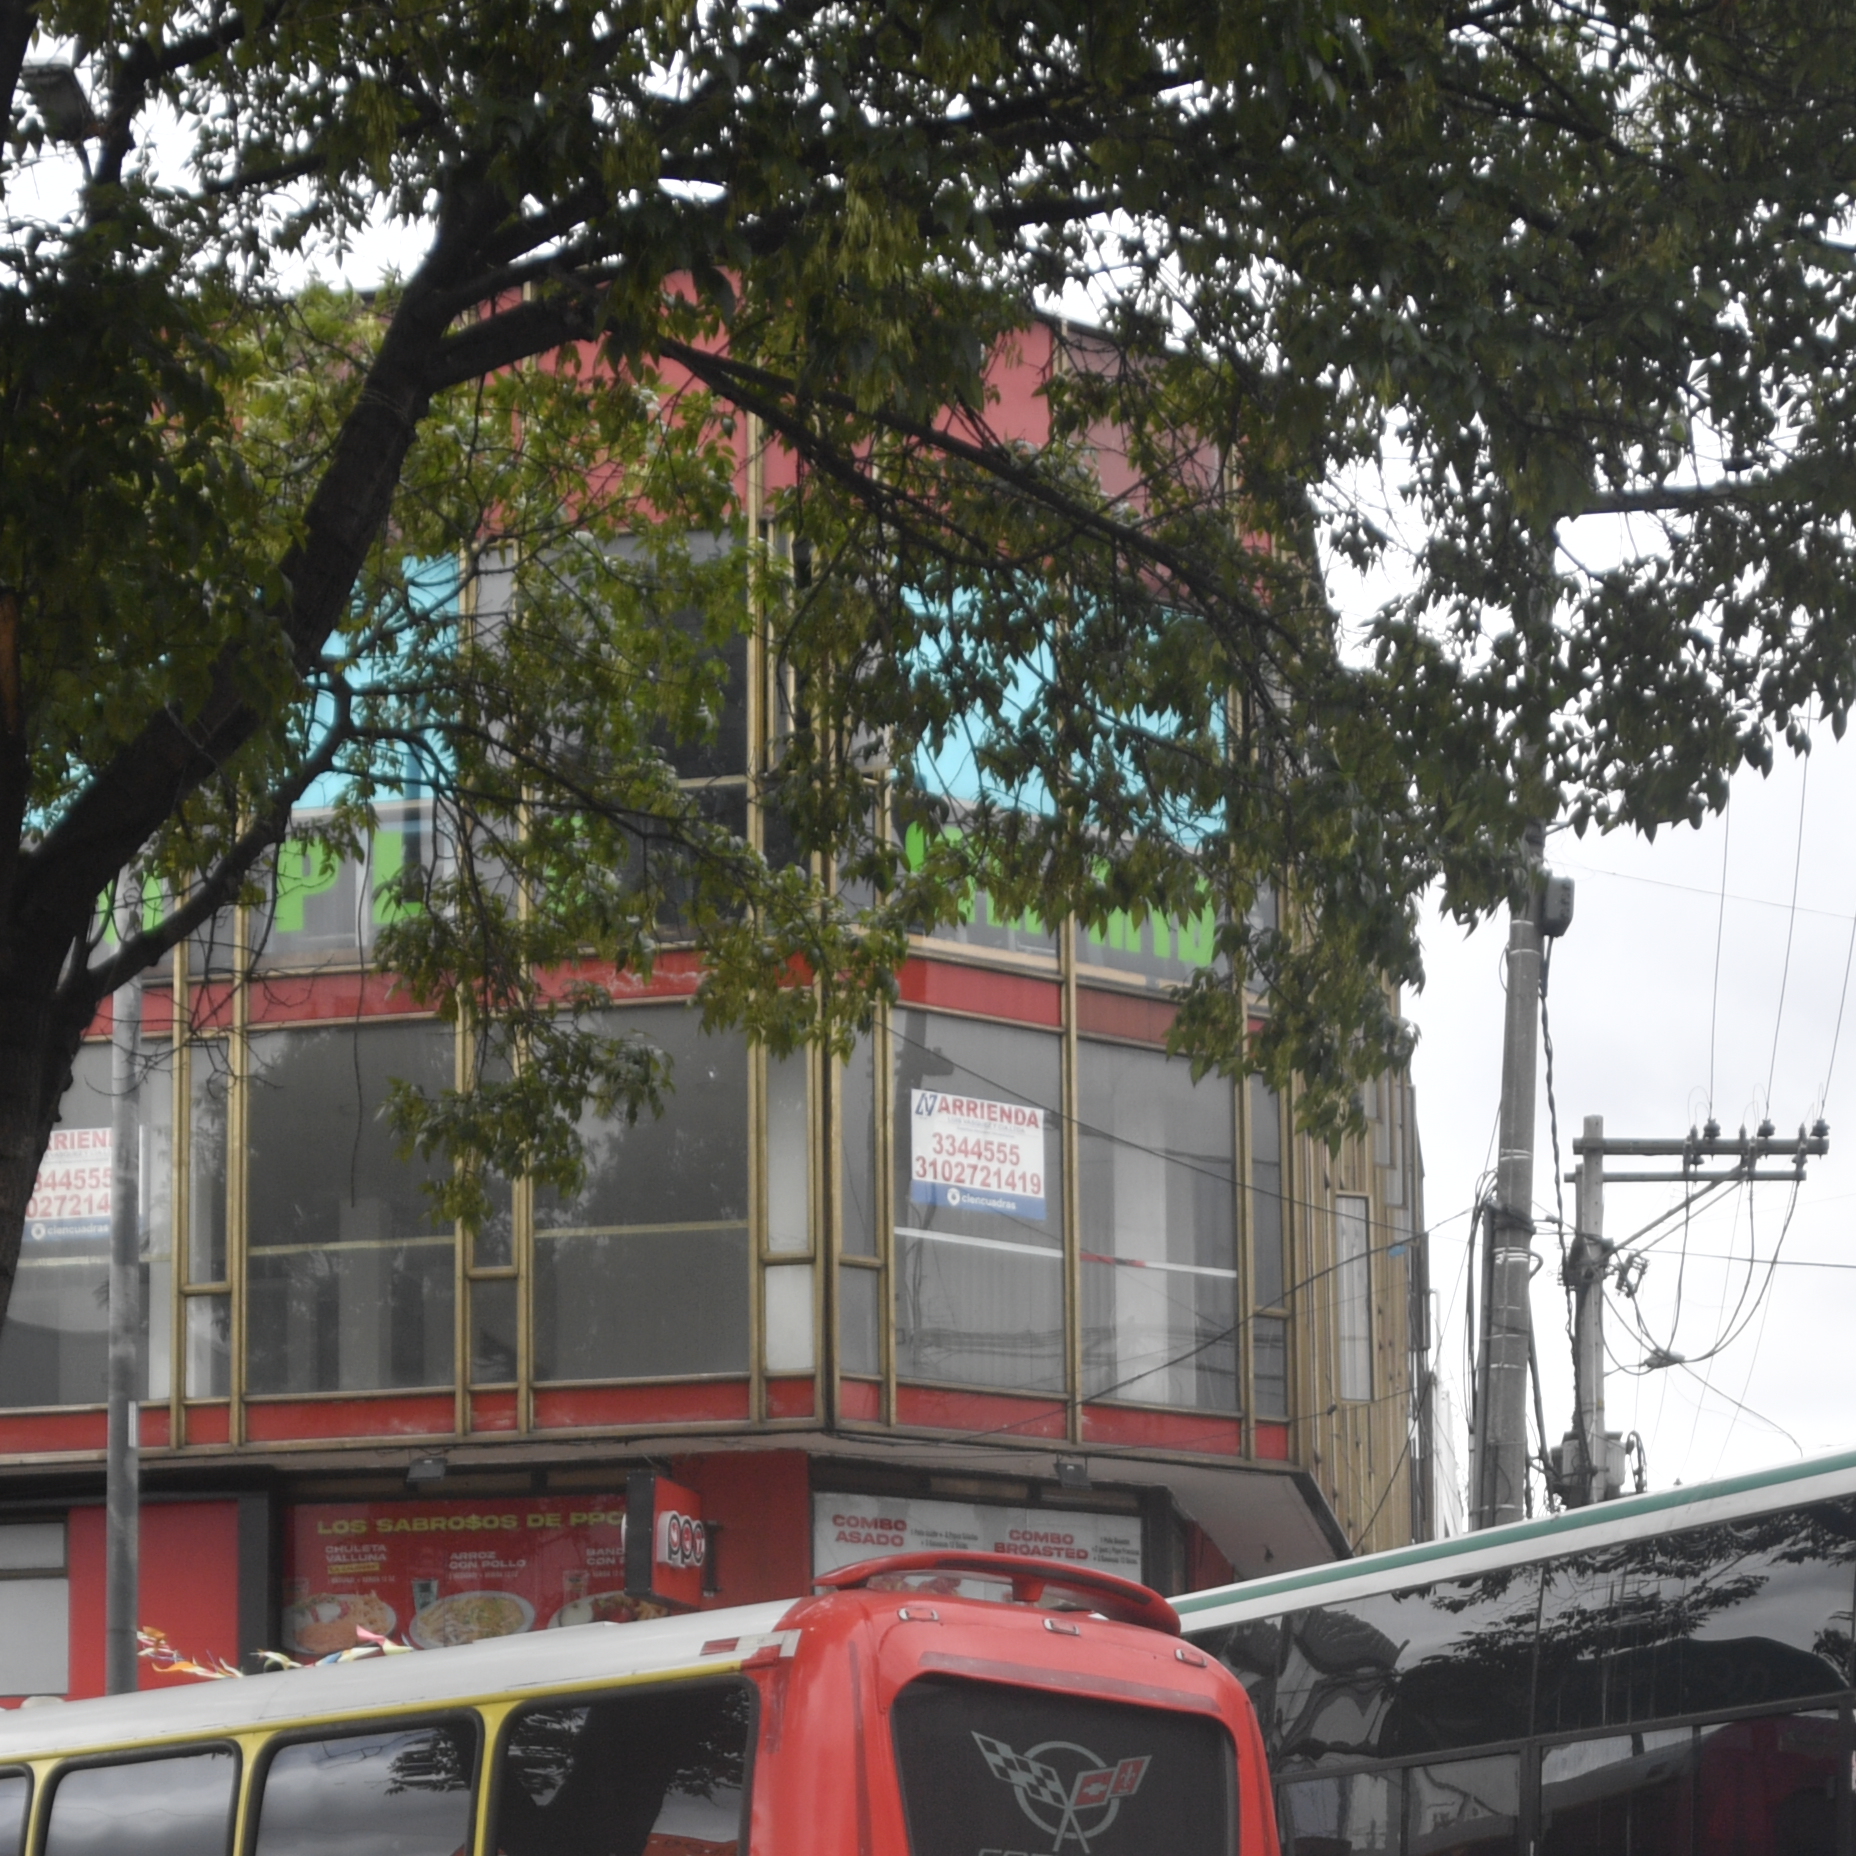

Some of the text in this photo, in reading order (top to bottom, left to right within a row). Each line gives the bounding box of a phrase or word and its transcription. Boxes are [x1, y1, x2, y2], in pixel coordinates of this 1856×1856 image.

[937, 1096, 1040, 1129] ARRIENDA
[932, 1132, 1020, 1166] 3344555
[915, 1155, 1042, 1195] 3102721419
[962, 1194, 1016, 1210] ciencuadras
[317, 1519, 367, 1534] LOS
[527, 1513, 561, 1527] DE
[832, 1513, 907, 1532] COMBO
[835, 1531, 904, 1547] ASADO
[1008, 1529, 1074, 1545] COMBO
[325, 1544, 387, 1553] CHULETA
[449, 1551, 497, 1559] ARROZ
[994, 1542, 1088, 1560] BROASTED
[326, 1554, 387, 1562] VALLUNA
[449, 1560, 526, 1569] CON POLLO
[586, 1558, 615, 1566] CON
